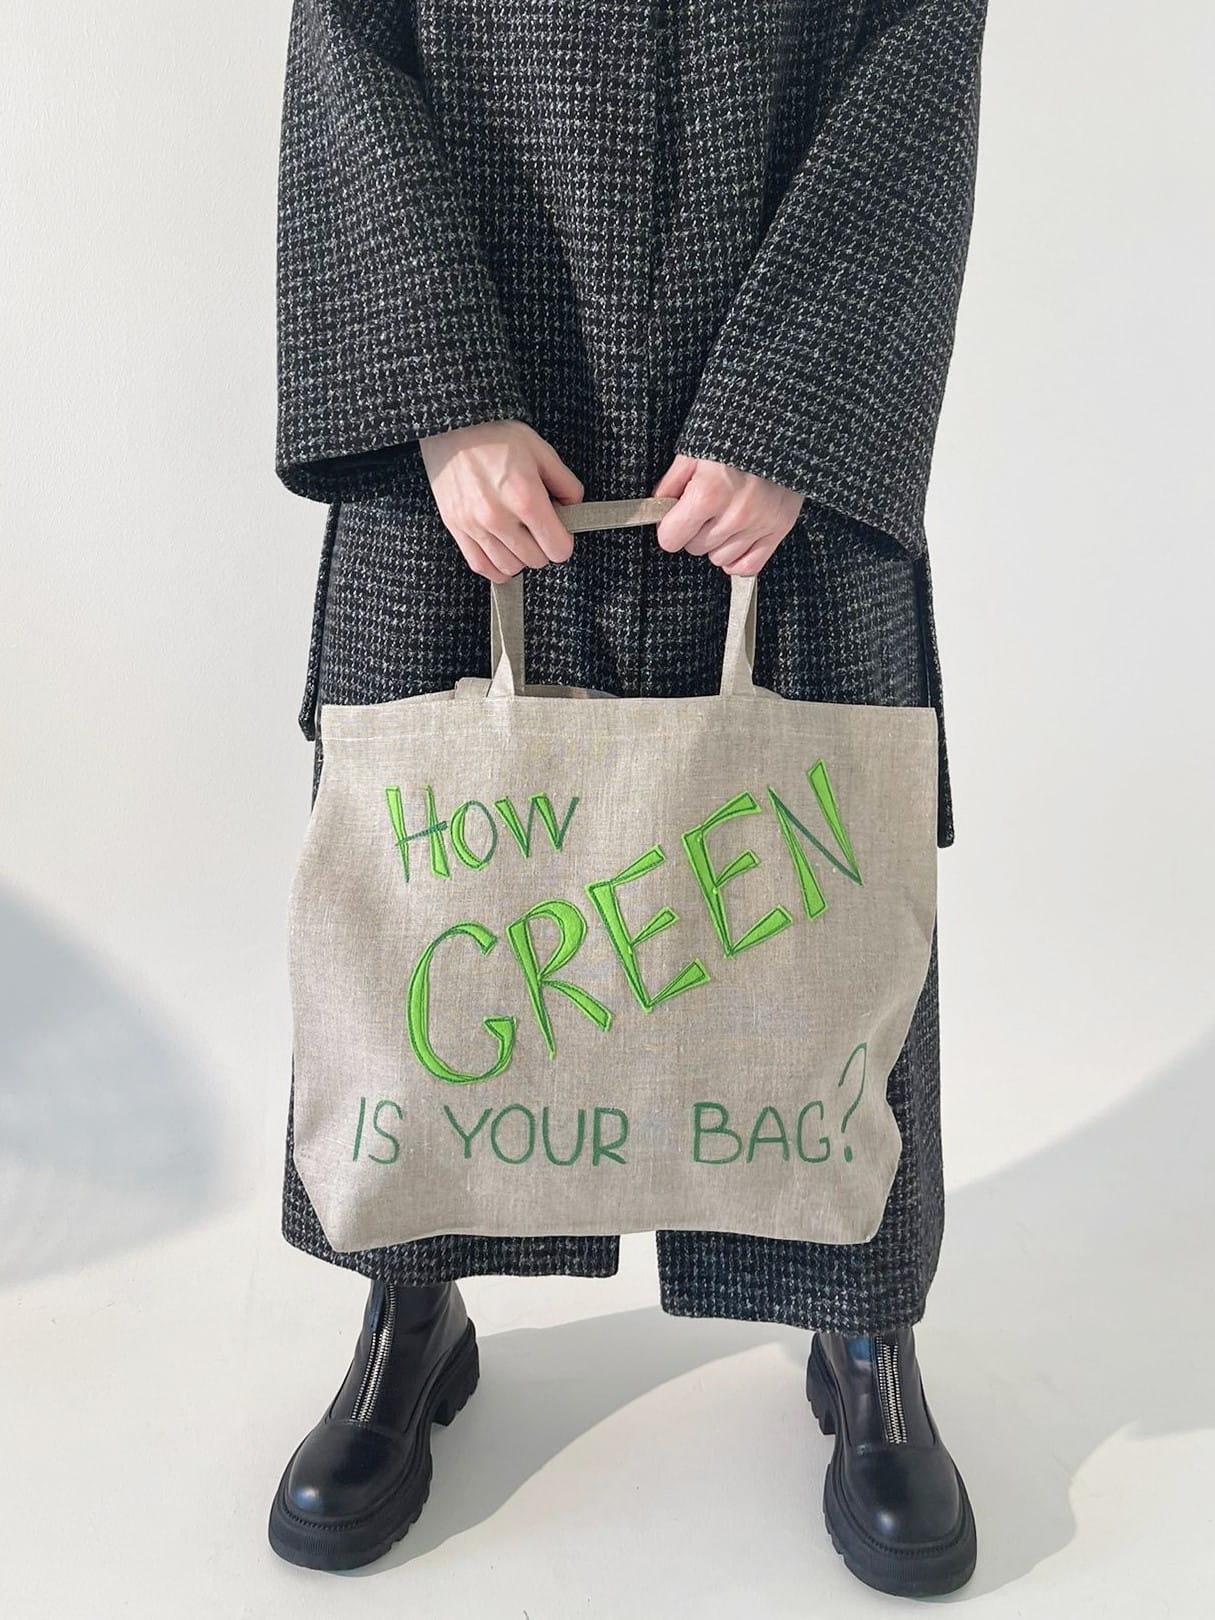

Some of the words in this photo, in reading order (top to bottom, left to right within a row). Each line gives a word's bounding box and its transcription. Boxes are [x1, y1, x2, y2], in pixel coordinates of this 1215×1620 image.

[405, 758, 864, 1087] GREEN
[352, 1096, 403, 1165] IS
[443, 1104, 629, 1167] YOUR
[692, 1042, 868, 1166] BAG?
